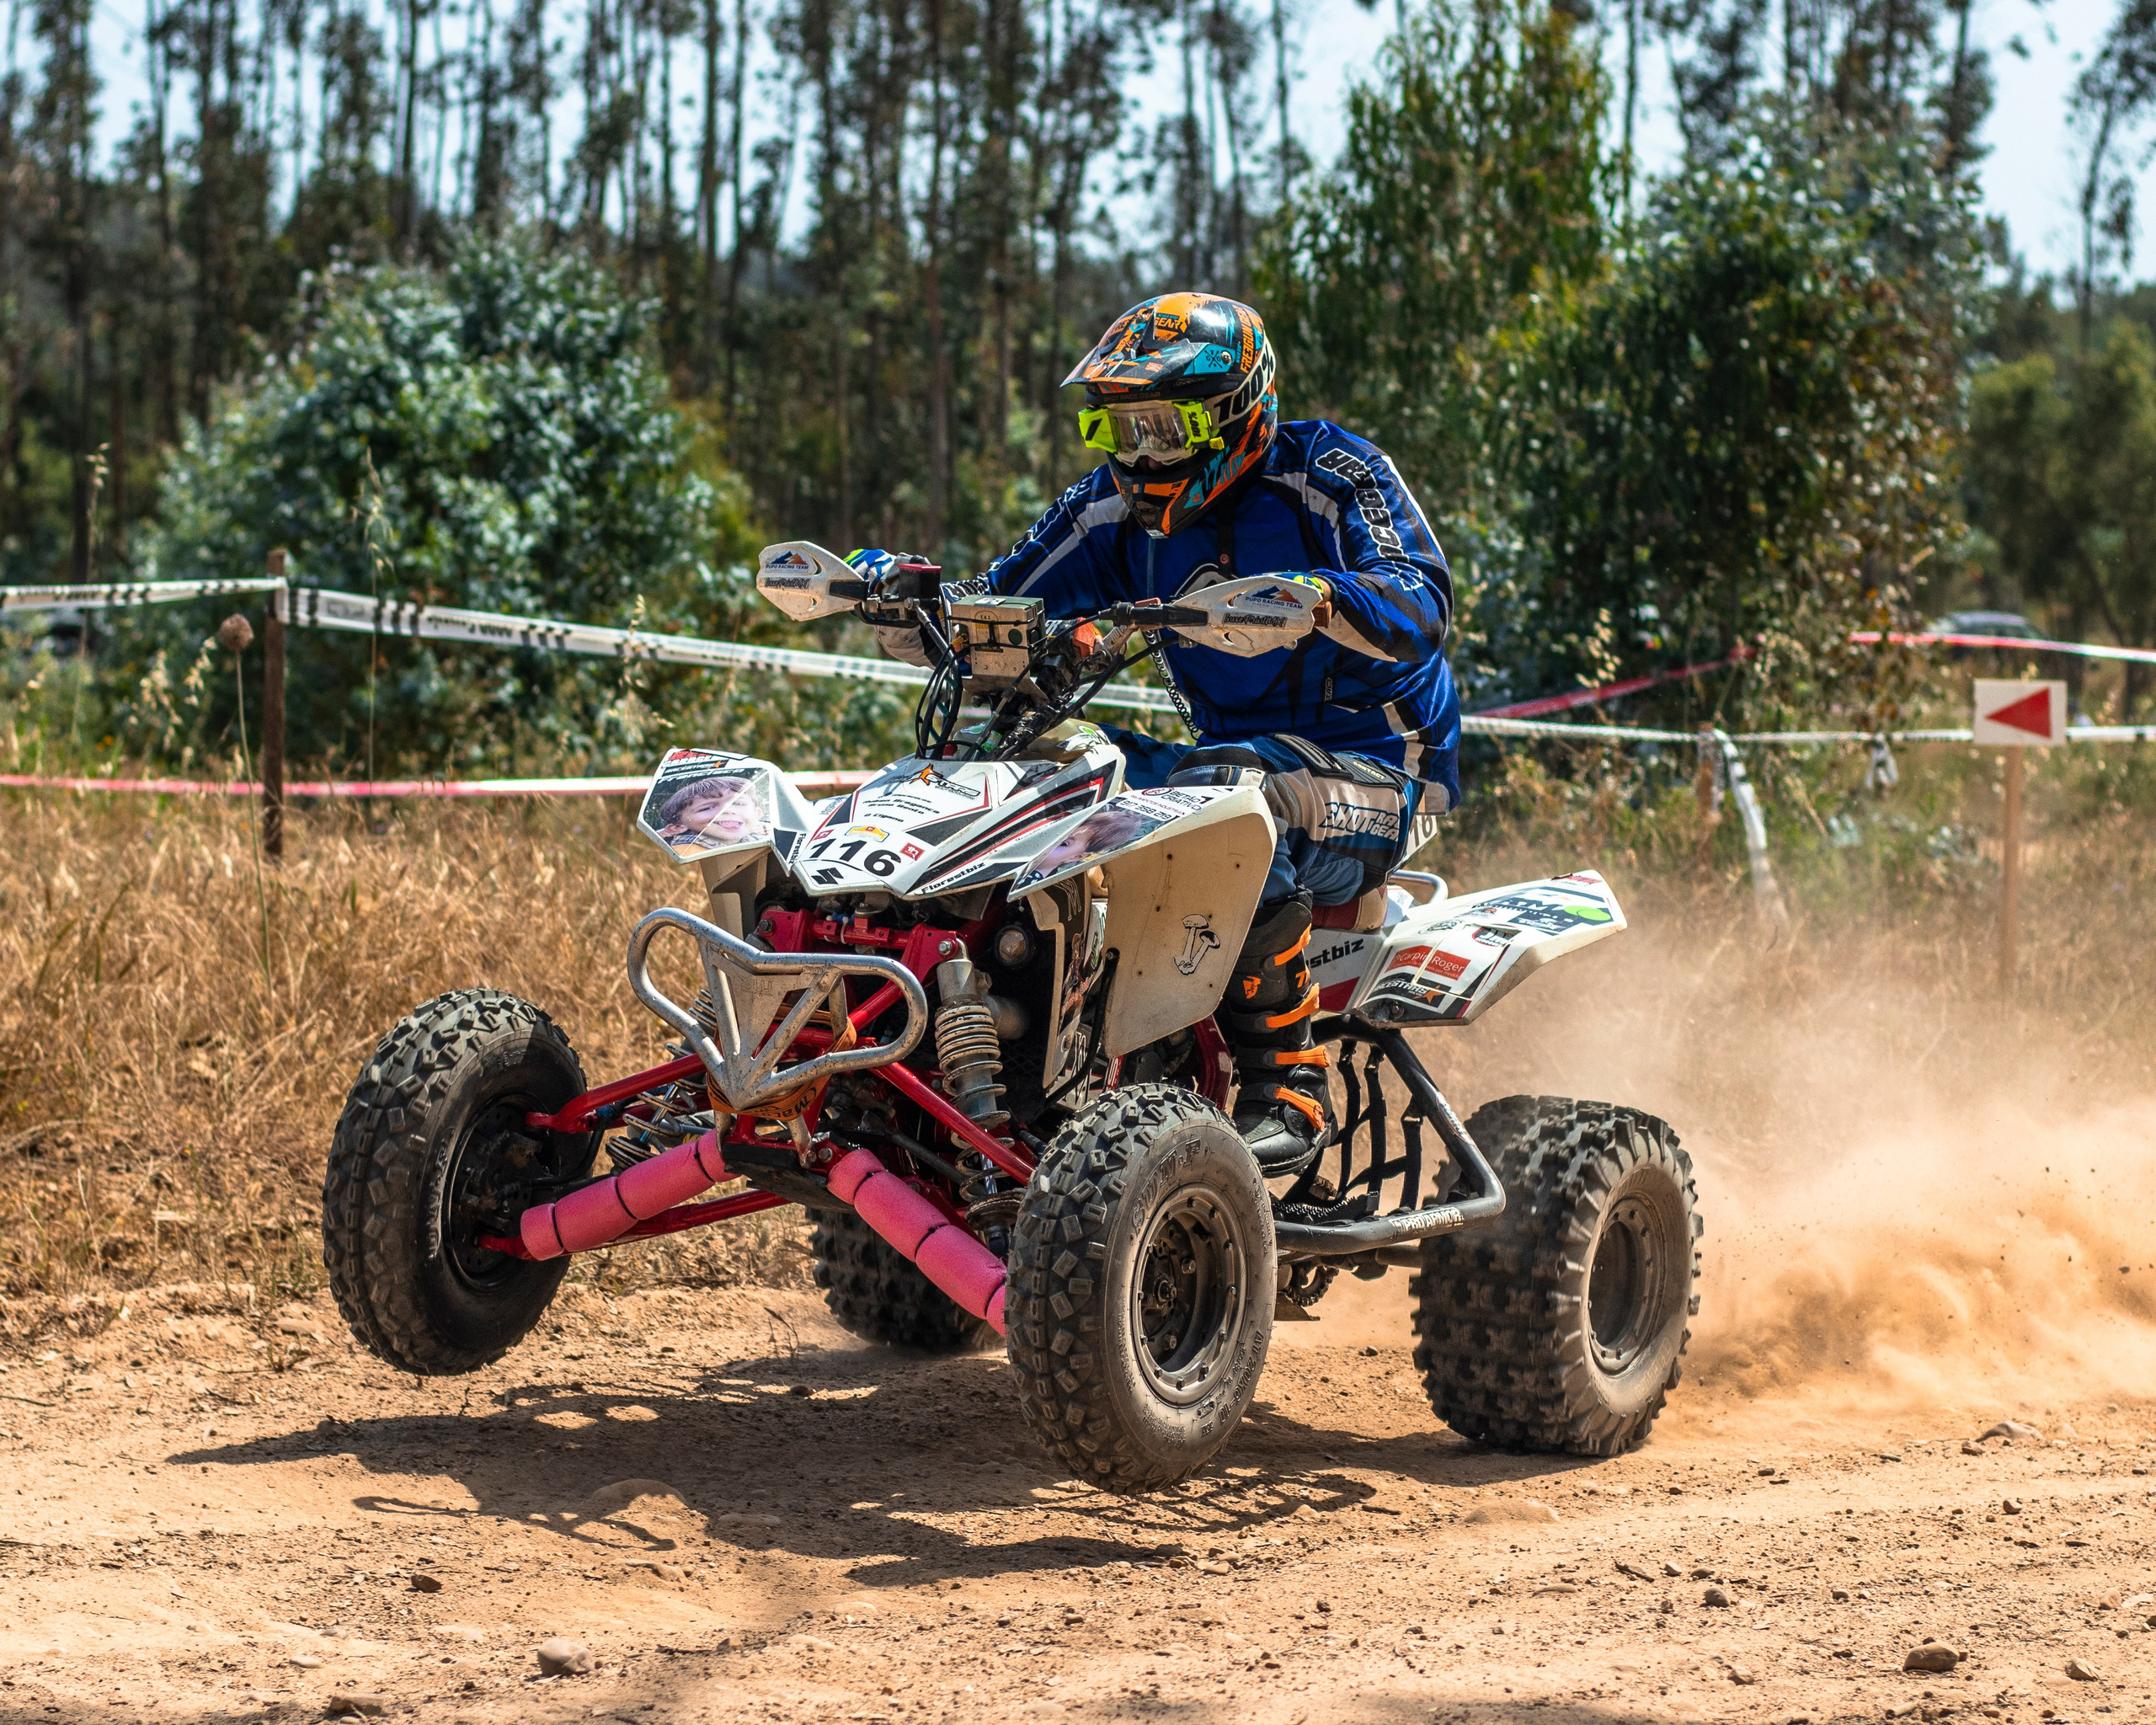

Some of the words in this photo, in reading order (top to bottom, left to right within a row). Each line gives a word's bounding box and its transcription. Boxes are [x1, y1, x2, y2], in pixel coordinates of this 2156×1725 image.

[1213, 344, 1274, 424] 100%
[1161, 794, 1202, 810] CRIATIVO
[1318, 802, 1376, 834] SHOT
[808, 838, 901, 877] 116
[921, 861, 985, 894] Florestbiz
[1431, 956, 1465, 972] Roger
[1404, 1217, 1426, 1231] PRO
[1426, 1210, 1460, 1227] ARMOR
